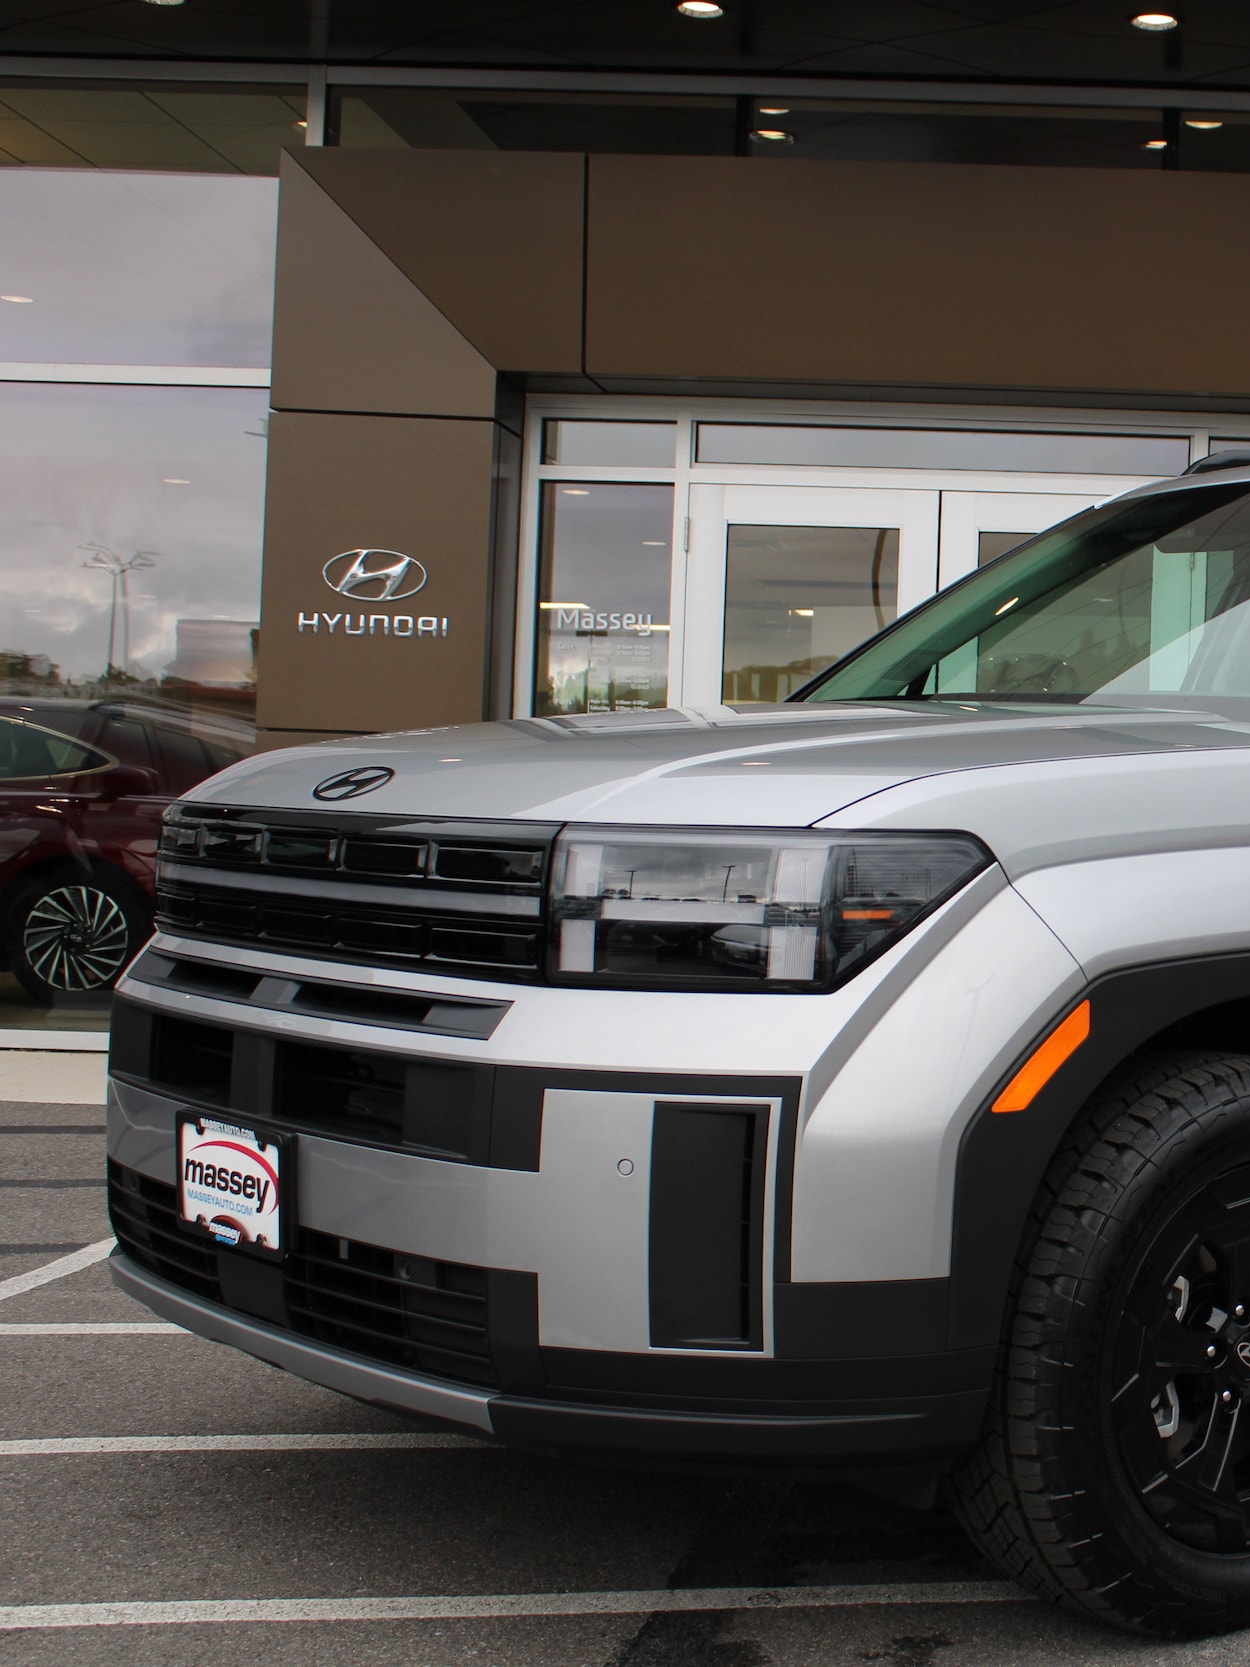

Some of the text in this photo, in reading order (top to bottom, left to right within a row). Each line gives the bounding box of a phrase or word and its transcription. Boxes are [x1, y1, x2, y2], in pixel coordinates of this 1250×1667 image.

[298, 611, 449, 639] HYUNDAI
[556, 607, 652, 637] Massey
[184, 1158, 270, 1214] massey
[187, 1188, 254, 1217] MASSEYAUTO.COM
[209, 1221, 241, 1245] massey
